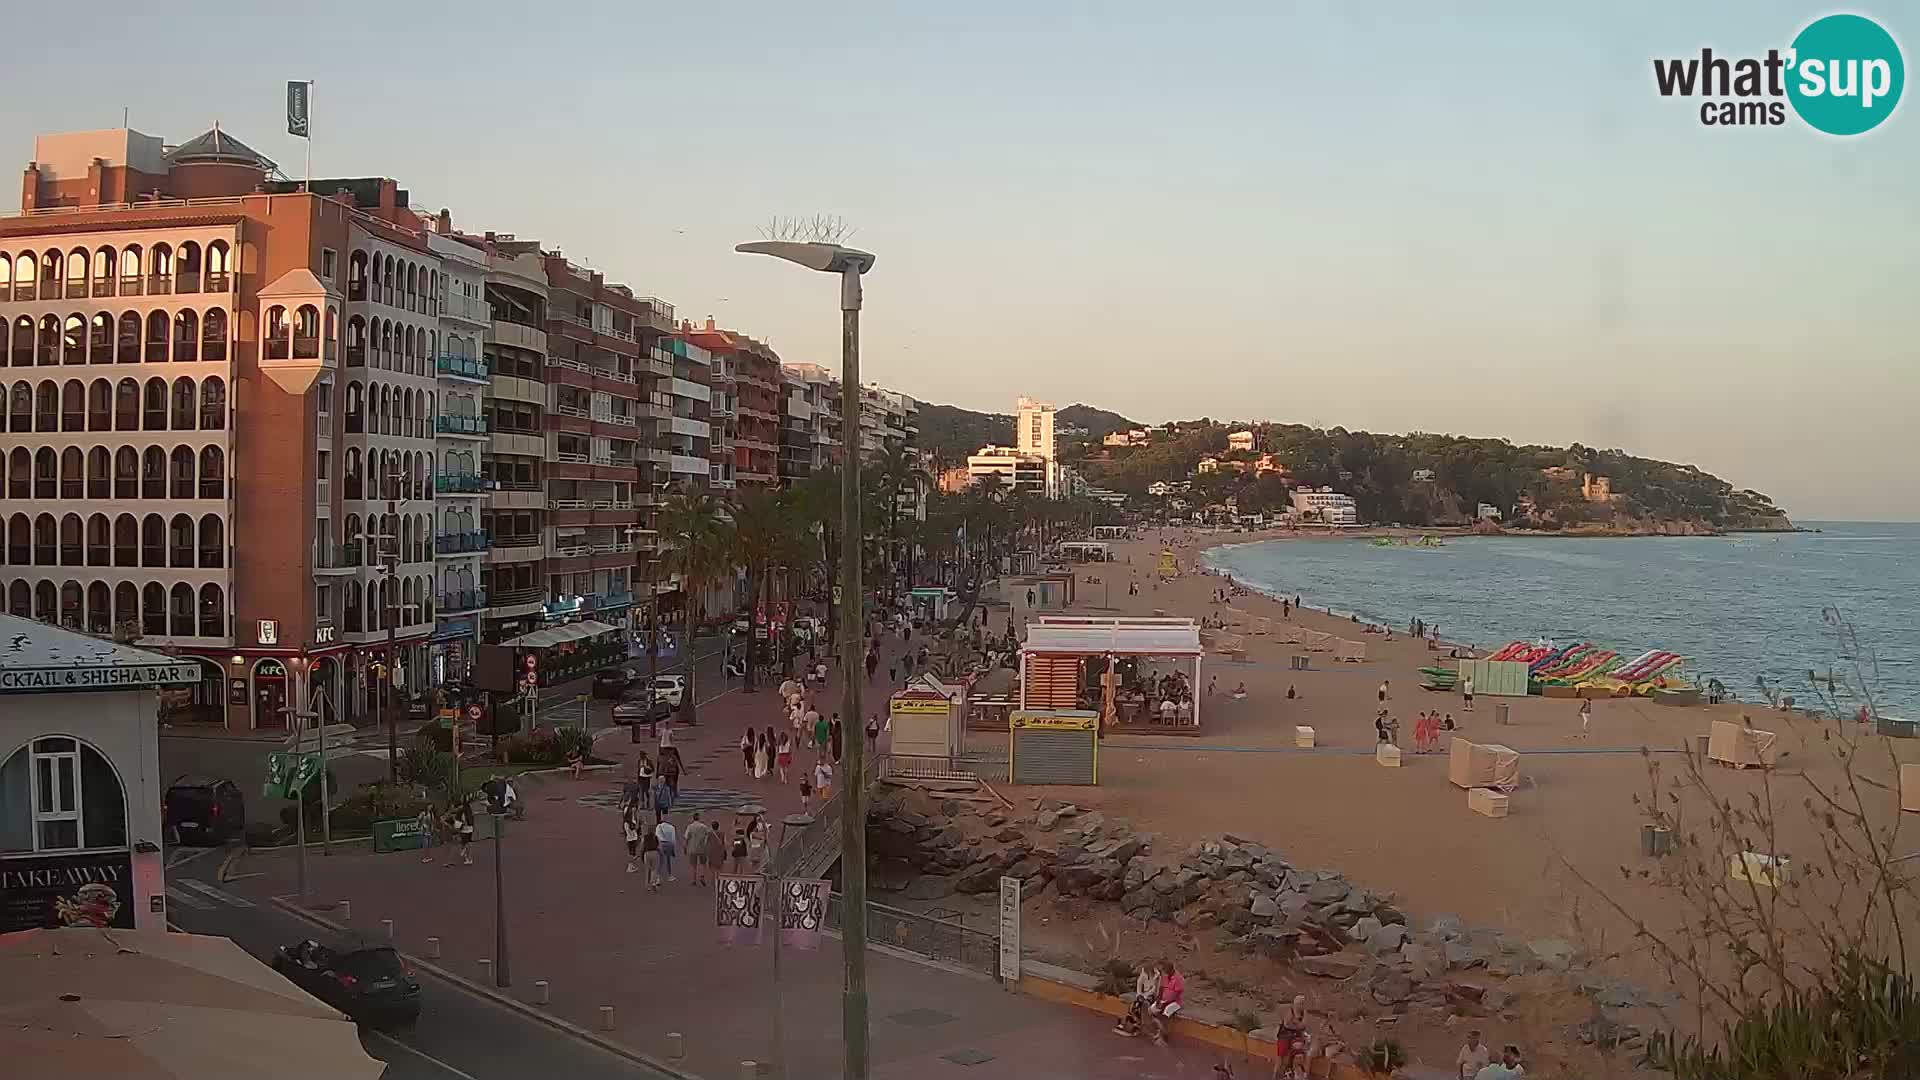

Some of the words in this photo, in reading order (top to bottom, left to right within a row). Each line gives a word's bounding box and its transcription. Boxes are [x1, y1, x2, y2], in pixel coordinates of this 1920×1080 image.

[315, 626, 335, 643] KFC
[65, 671, 76, 685] &
[82, 669, 143, 685] SHISHA
[150, 667, 180, 682] BAR
[260, 665, 284, 675] KFC
